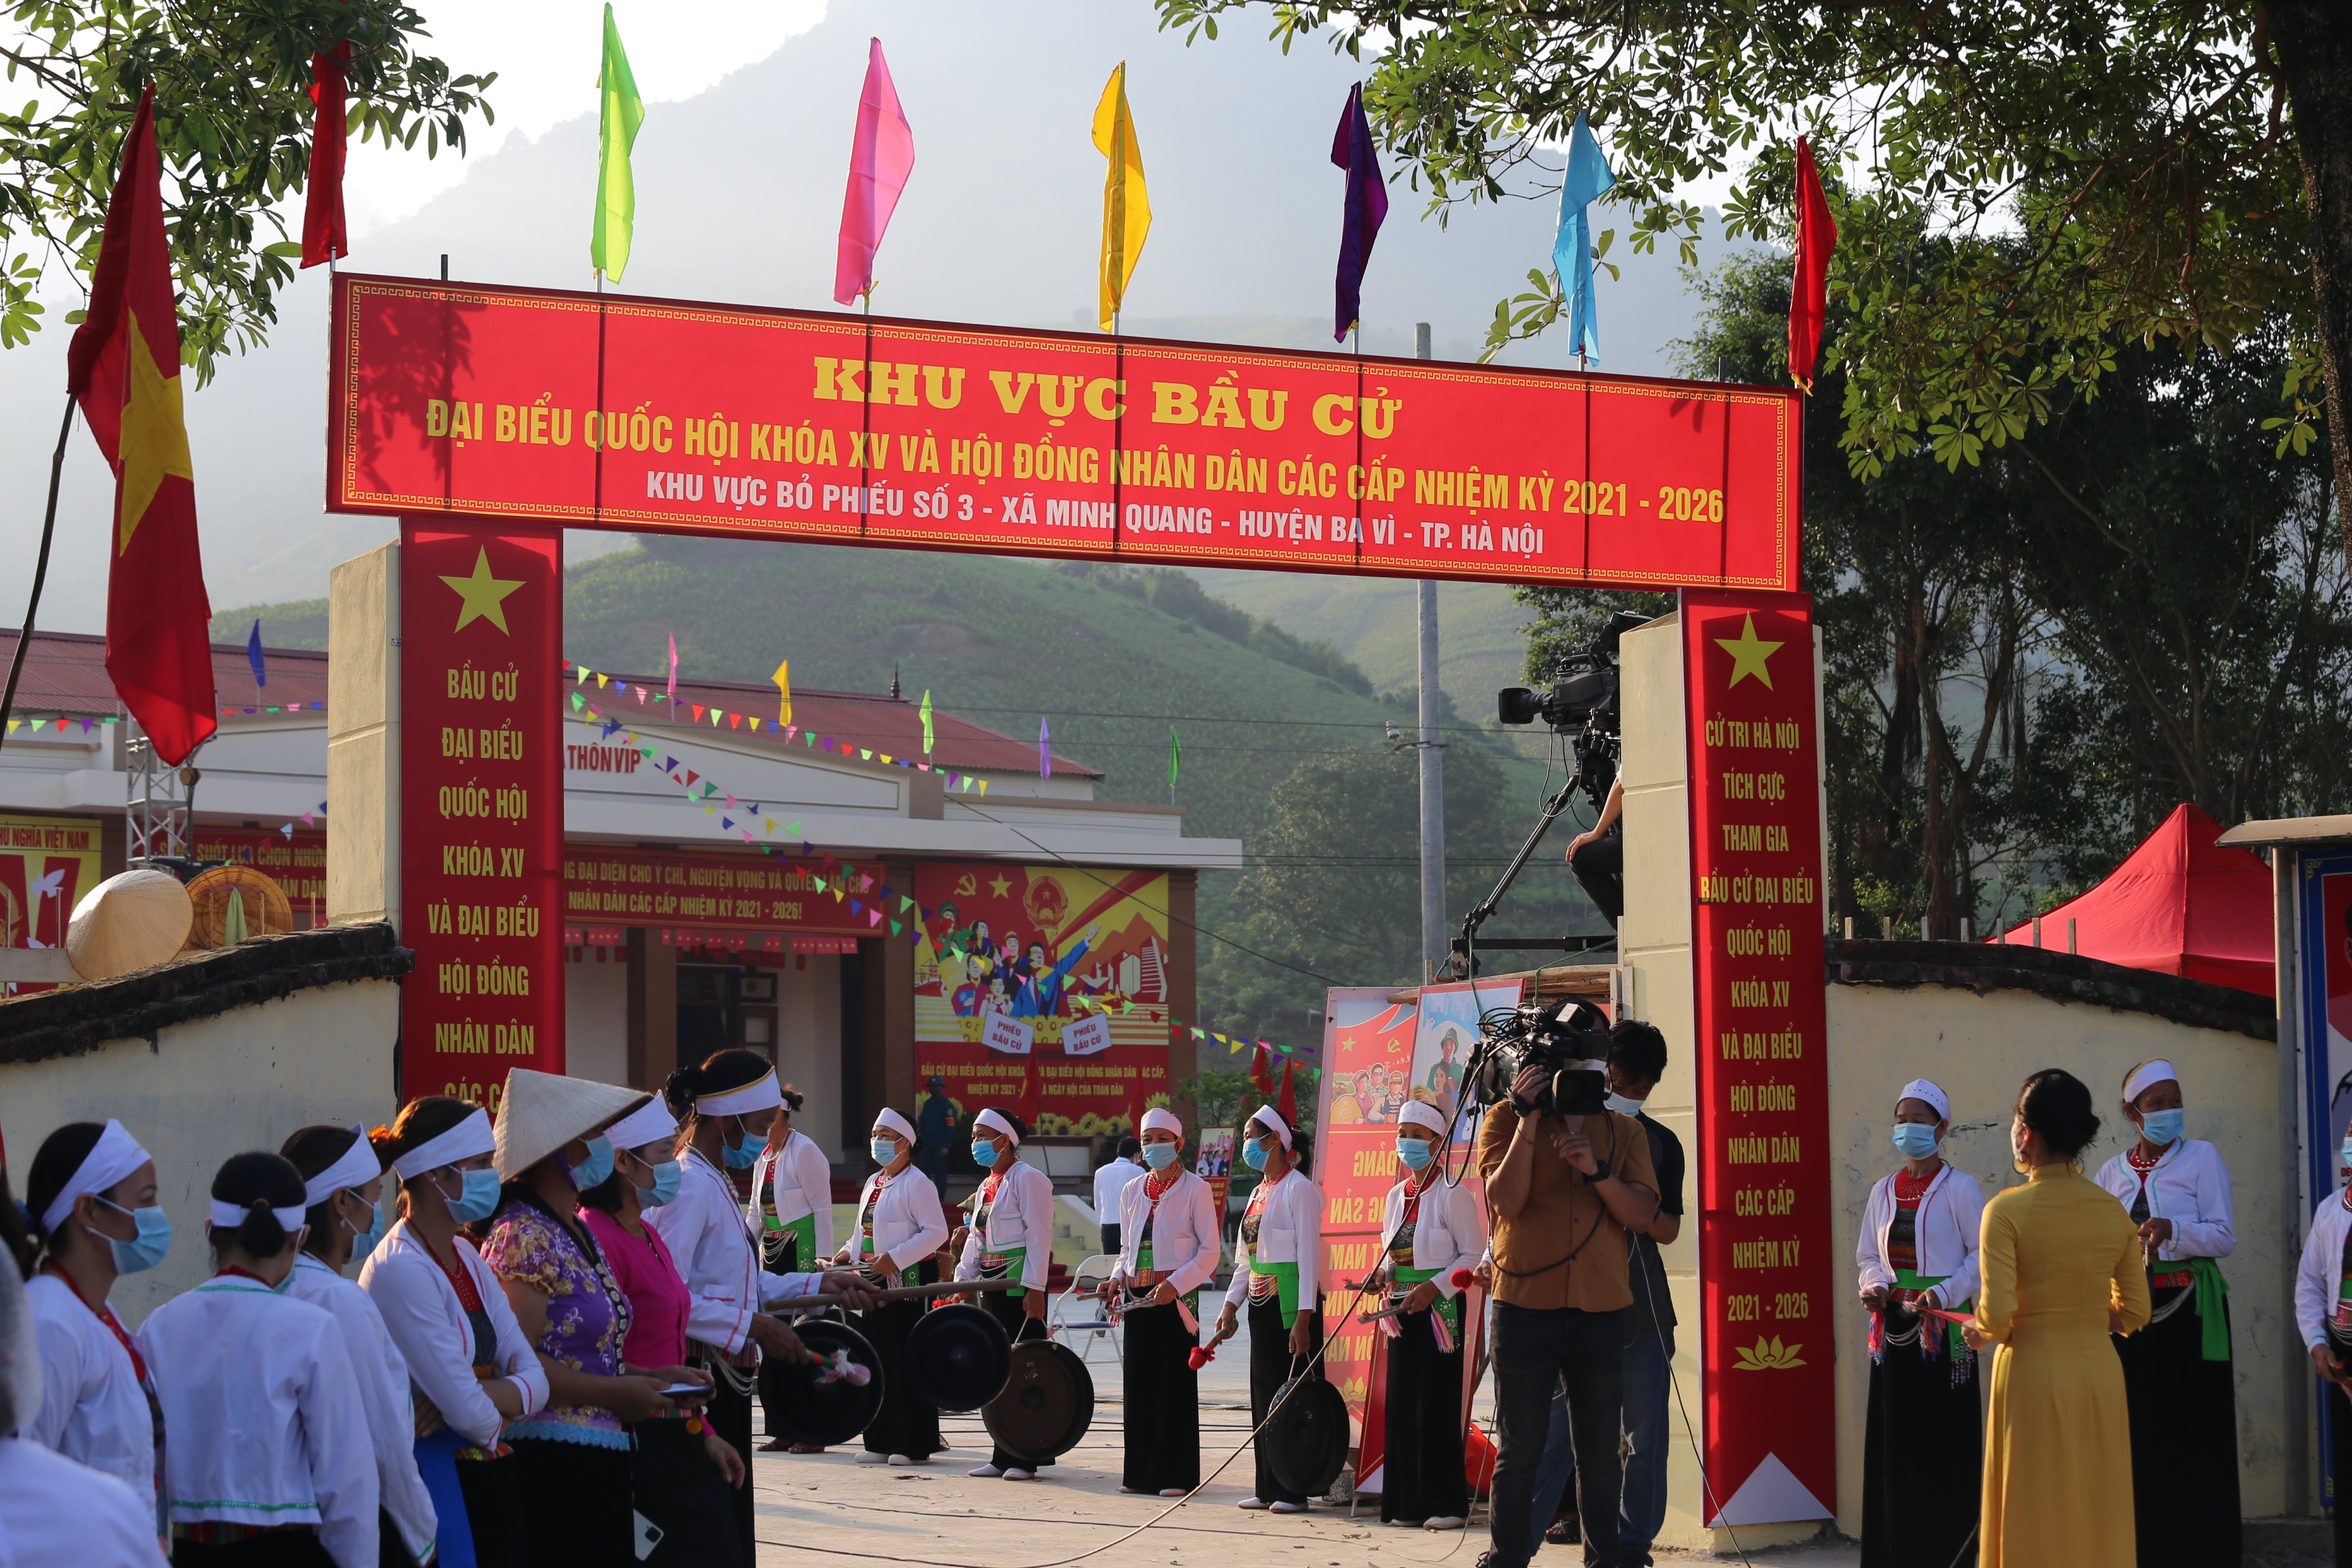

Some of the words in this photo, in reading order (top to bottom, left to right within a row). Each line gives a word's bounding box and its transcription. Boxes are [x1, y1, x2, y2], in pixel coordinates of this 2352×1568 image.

[813, 356, 965, 410] KHU
[989, 370, 1128, 427] VỰC
[1152, 370, 1288, 431] BẦU
[1312, 387, 1402, 439] CỬ
[426, 399, 482, 448] ĐẠI
[496, 392, 572, 446] BIỂU
[584, 400, 673, 454] QUỐC
[685, 412, 739, 466] HỘI
[750, 419, 837, 466] KHÓA
[849, 431, 889, 469] XV
[901, 428, 940, 473] VÀ
[956, 433, 1002, 485] HỘI
[1013, 432, 1099, 484] ĐỒNG
[1110, 445, 1195, 489] NHÂN
[1206, 449, 1267, 493] DÂN
[1278, 454, 1337, 498] CÁC
[1347, 454, 1405, 502] CẤP
[1415, 466, 1509, 515] NHIỆM
[1519, 470, 1551, 513] KỲ
[1563, 480, 1627, 517] 2021
[1658, 486, 1724, 523] 2026
[647, 471, 702, 501] KHU
[713, 475, 767, 511] VỰC
[777, 472, 813, 510] BỎ
[823, 479, 903, 516] PHIẾU
[913, 483, 950, 519] SỐ
[957, 493, 974, 522] 3
[1001, 491, 1038, 525] XÃ
[1045, 499, 1116, 529] MINH
[1125, 503, 1212, 534] QUANG
[1239, 507, 1322, 547] HUYỆN
[1331, 515, 1364, 544] BA
[1373, 513, 1395, 546] VÌ
[1420, 522, 1453, 549] TP.
[1461, 520, 1493, 551] HÀ
[1501, 523, 1544, 559] NỘI
[447, 659, 485, 700] BẦU
[492, 662, 519, 702] CỬ
[442, 727, 474, 764] ĐẠI
[480, 718, 523, 760] BIỂU
[1705, 712, 1725, 747] CỬ
[1728, 721, 1749, 747] TRI
[1754, 717, 1772, 748] HÀ
[1776, 717, 1799, 755] NỘI
[439, 777, 490, 819] QUỐC
[496, 783, 527, 825] HỘI
[1723, 767, 1754, 799] TÍCH
[1758, 771, 1785, 805] CỰC
[44, 825, 65, 853] VIỆT
[67, 831, 90, 850] NAM
[1723, 824, 1762, 851] THAM
[1766, 825, 1789, 851] GIA
[443, 840, 494, 876] KHÓA
[500, 848, 524, 878] XV
[578, 862, 597, 885] ĐẠI
[600, 860, 627, 886] DIỆN
[629, 864, 652, 883] CHO
[655, 862, 662, 884] Ý
[690, 866, 733, 891] NGUYỆN
[736, 870, 765, 893] VỌNG
[768, 868, 782, 890] VÀ
[569, 888, 600, 910] NHÂN
[603, 889, 627, 912] DÂN
[629, 891, 652, 913] CÁC
[655, 890, 677, 914] CẤP
[680, 894, 716, 920] NHIỆM
[719, 895, 733, 917] KỲ
[736, 899, 761, 918] 2021
[772, 901, 802, 920] 2026!
[1701, 867, 1728, 903] BẦU
[1733, 868, 1752, 903] CỬ
[1755, 877, 1778, 909] ĐẠI
[1783, 867, 1813, 904] BIỂU
[427, 898, 453, 934] VÀ
[458, 905, 490, 942] ĐẠI
[496, 894, 539, 937] BIỂU
[1727, 920, 1764, 958] QUỐC
[1768, 924, 1791, 961] HỘI
[439, 957, 470, 1001] HỘI
[476, 955, 529, 996] ĐỒNG
[1731, 975, 1768, 1007] KHÓA
[1772, 981, 1790, 1007] XV
[435, 1017, 489, 1054] NHÂN
[495, 1018, 534, 1055] DÂN
[997, 1021, 1022, 1036] PHIẾU
[1073, 1022, 1096, 1038] PHIẾU
[1721, 1028, 1740, 1059] VÀ
[1743, 1033, 1767, 1065] ĐẠI
[1771, 1022, 1802, 1059] BIỂU
[1731, 1080, 1753, 1118] HỘI
[1758, 1076, 1795, 1111] ĐỒNG
[1728, 1131, 1767, 1164] NHÂN
[1771, 1131, 1800, 1163] DÂN
[1736, 1184, 1763, 1216] CÁC
[1767, 1179, 1795, 1215] CẤP
[1733, 1236, 1779, 1273] NHIỆM
[1783, 1235, 1800, 1267] KỲ
[1728, 1295, 1759, 1321] 2021
[1775, 1292, 1808, 1319] 2026
